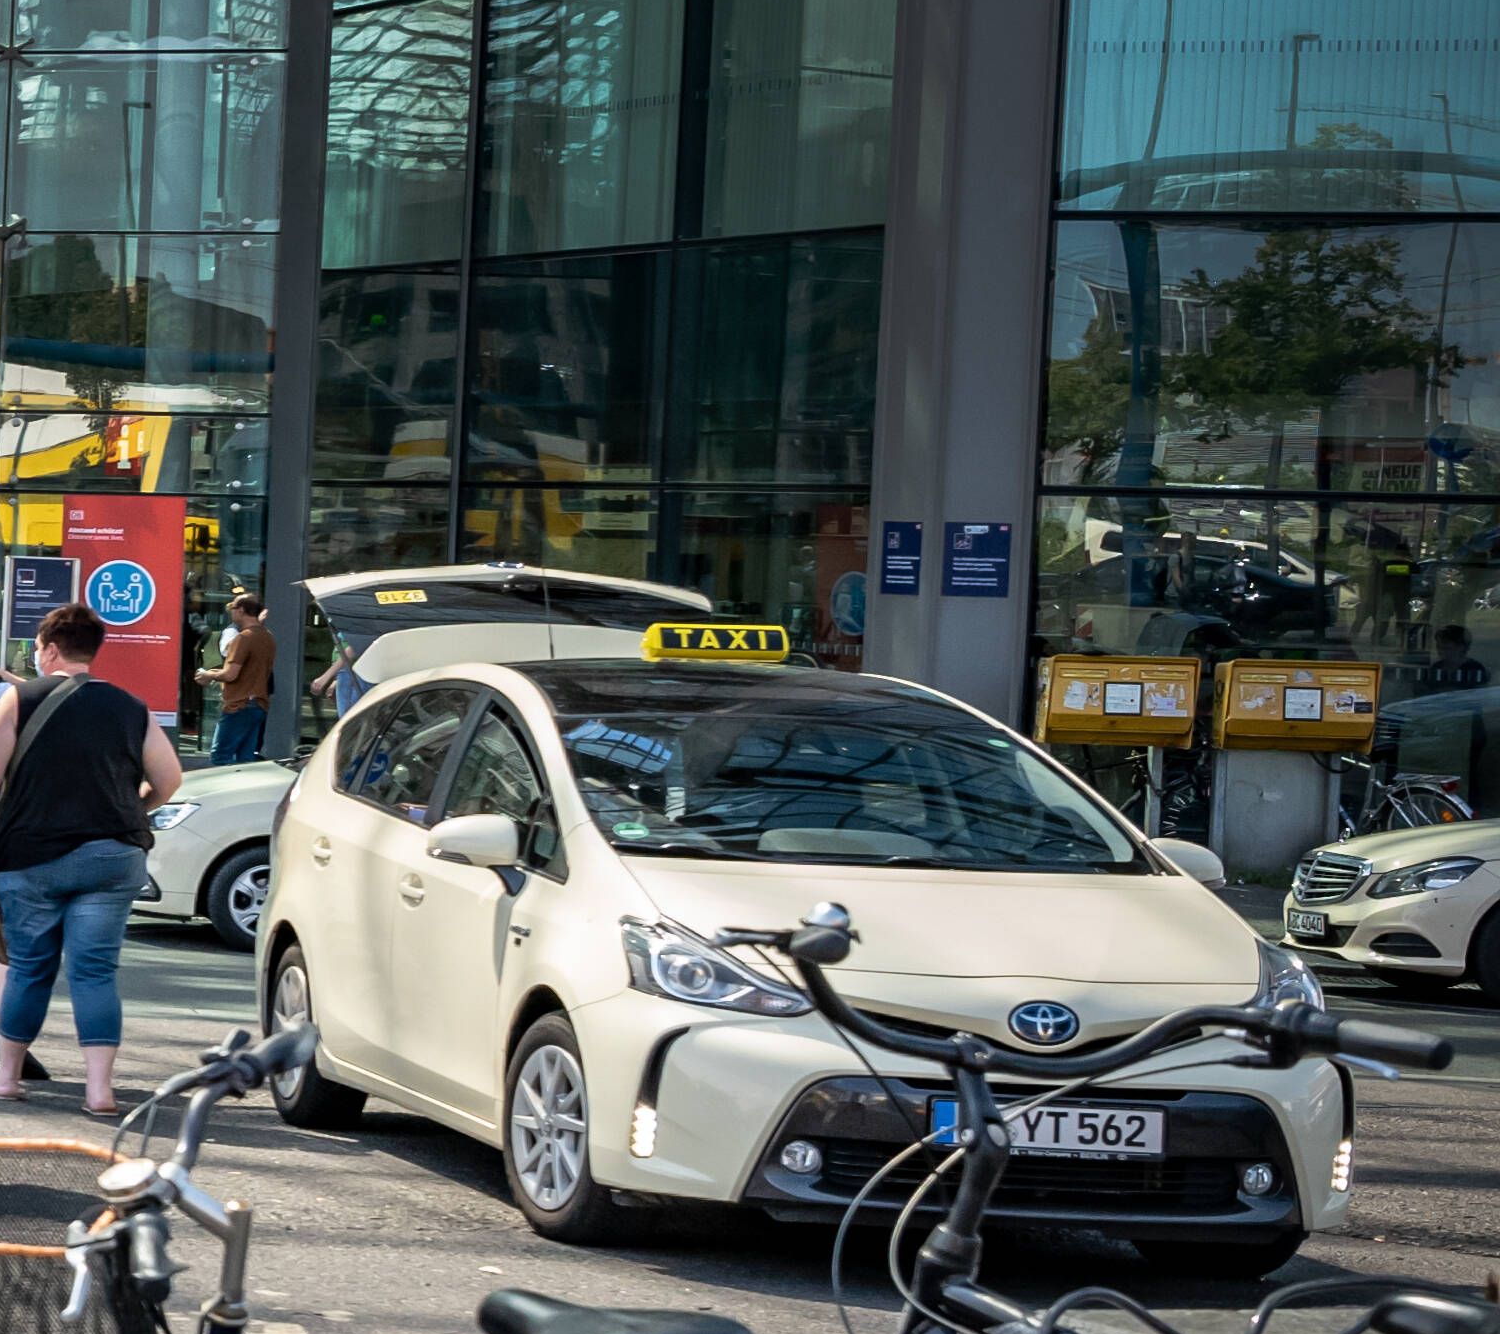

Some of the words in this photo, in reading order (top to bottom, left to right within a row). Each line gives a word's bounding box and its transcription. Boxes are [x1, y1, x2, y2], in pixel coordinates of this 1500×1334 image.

[674, 629, 767, 650] TAXI
[1021, 1111, 1069, 1143] YT
[1077, 1113, 1146, 1148] 562
